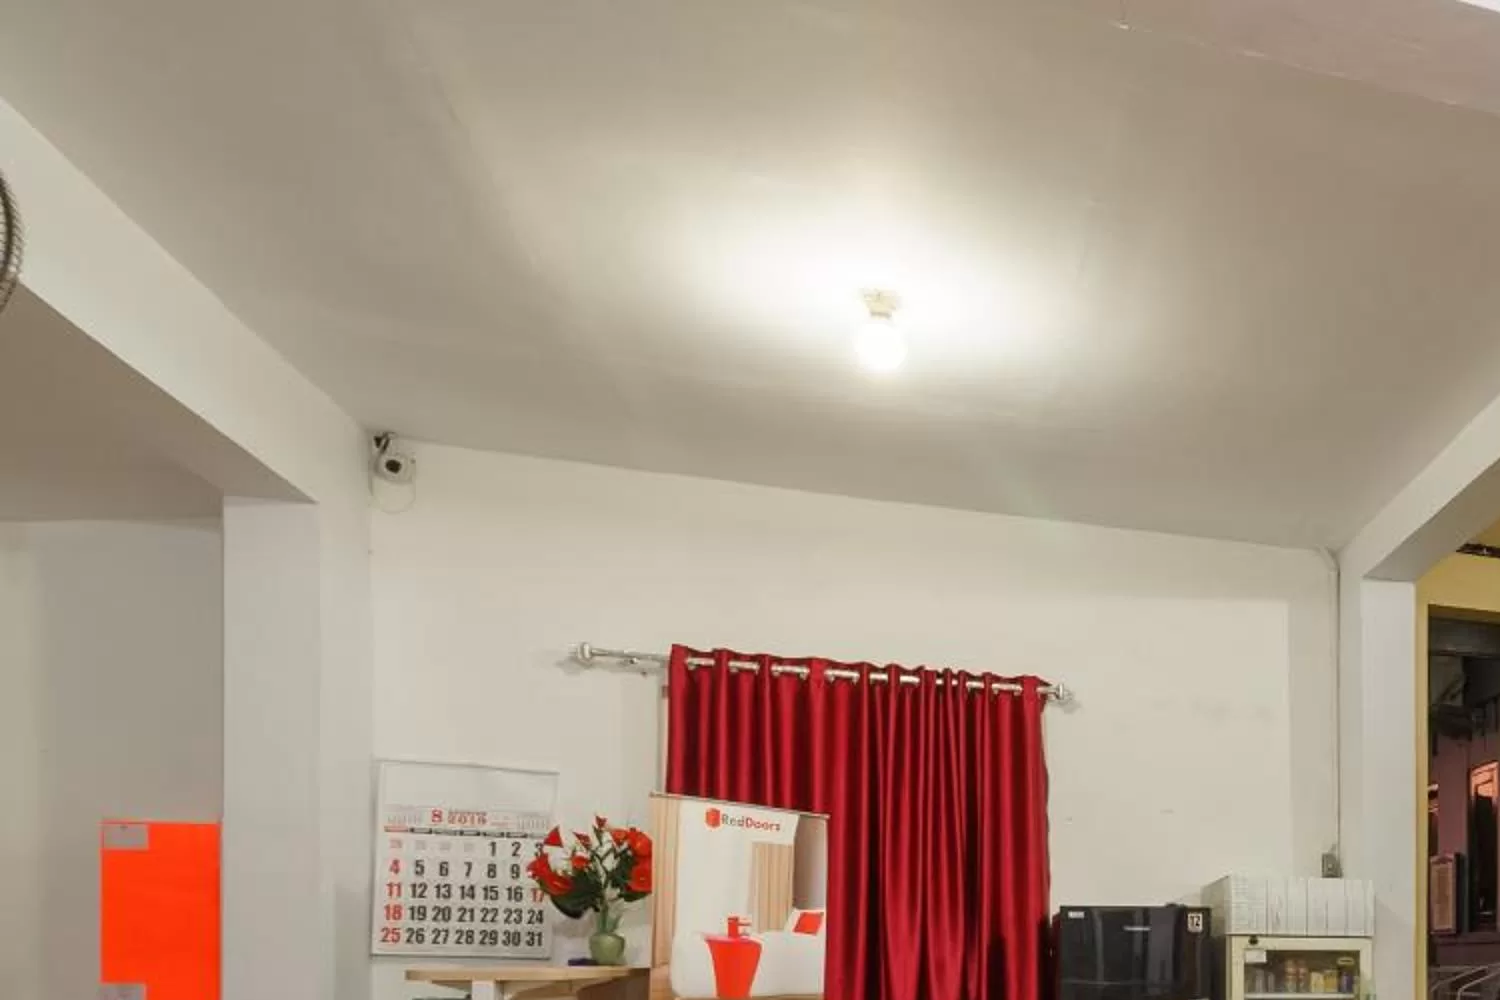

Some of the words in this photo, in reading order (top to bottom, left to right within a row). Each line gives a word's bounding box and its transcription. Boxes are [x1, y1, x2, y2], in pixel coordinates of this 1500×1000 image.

[431, 809, 443, 824] 8
[489, 841, 497, 857] 1
[511, 842, 521, 857] 2
[390, 859, 401, 874] 4
[415, 860, 425, 877] 5
[439, 861, 449, 877] 6
[463, 862, 473, 878] 7
[487, 862, 497, 879] 8
[510, 864, 520, 880] 9
[386, 882, 401, 897] 11
[409, 882, 428, 899] 12
[435, 883, 451, 899] 13
[459, 885, 476, 901] 14
[482, 886, 499, 902] 15
[506, 887, 523, 903] 16
[384, 904, 402, 921] 18
[408, 905, 427, 922] 19
[432, 907, 451, 923] 20
[457, 908, 475, 923] 21
[480, 908, 498, 924] 22
[503, 909, 522, 925] 23
[527, 909, 545, 925] 24
[380, 927, 401, 944] 25
[405, 927, 425, 944] 26
[431, 929, 450, 945] 27
[454, 929, 474, 946] 28
[479, 930, 498, 947] 29
[502, 930, 521, 947] 30
[525, 931, 543, 948] 31
